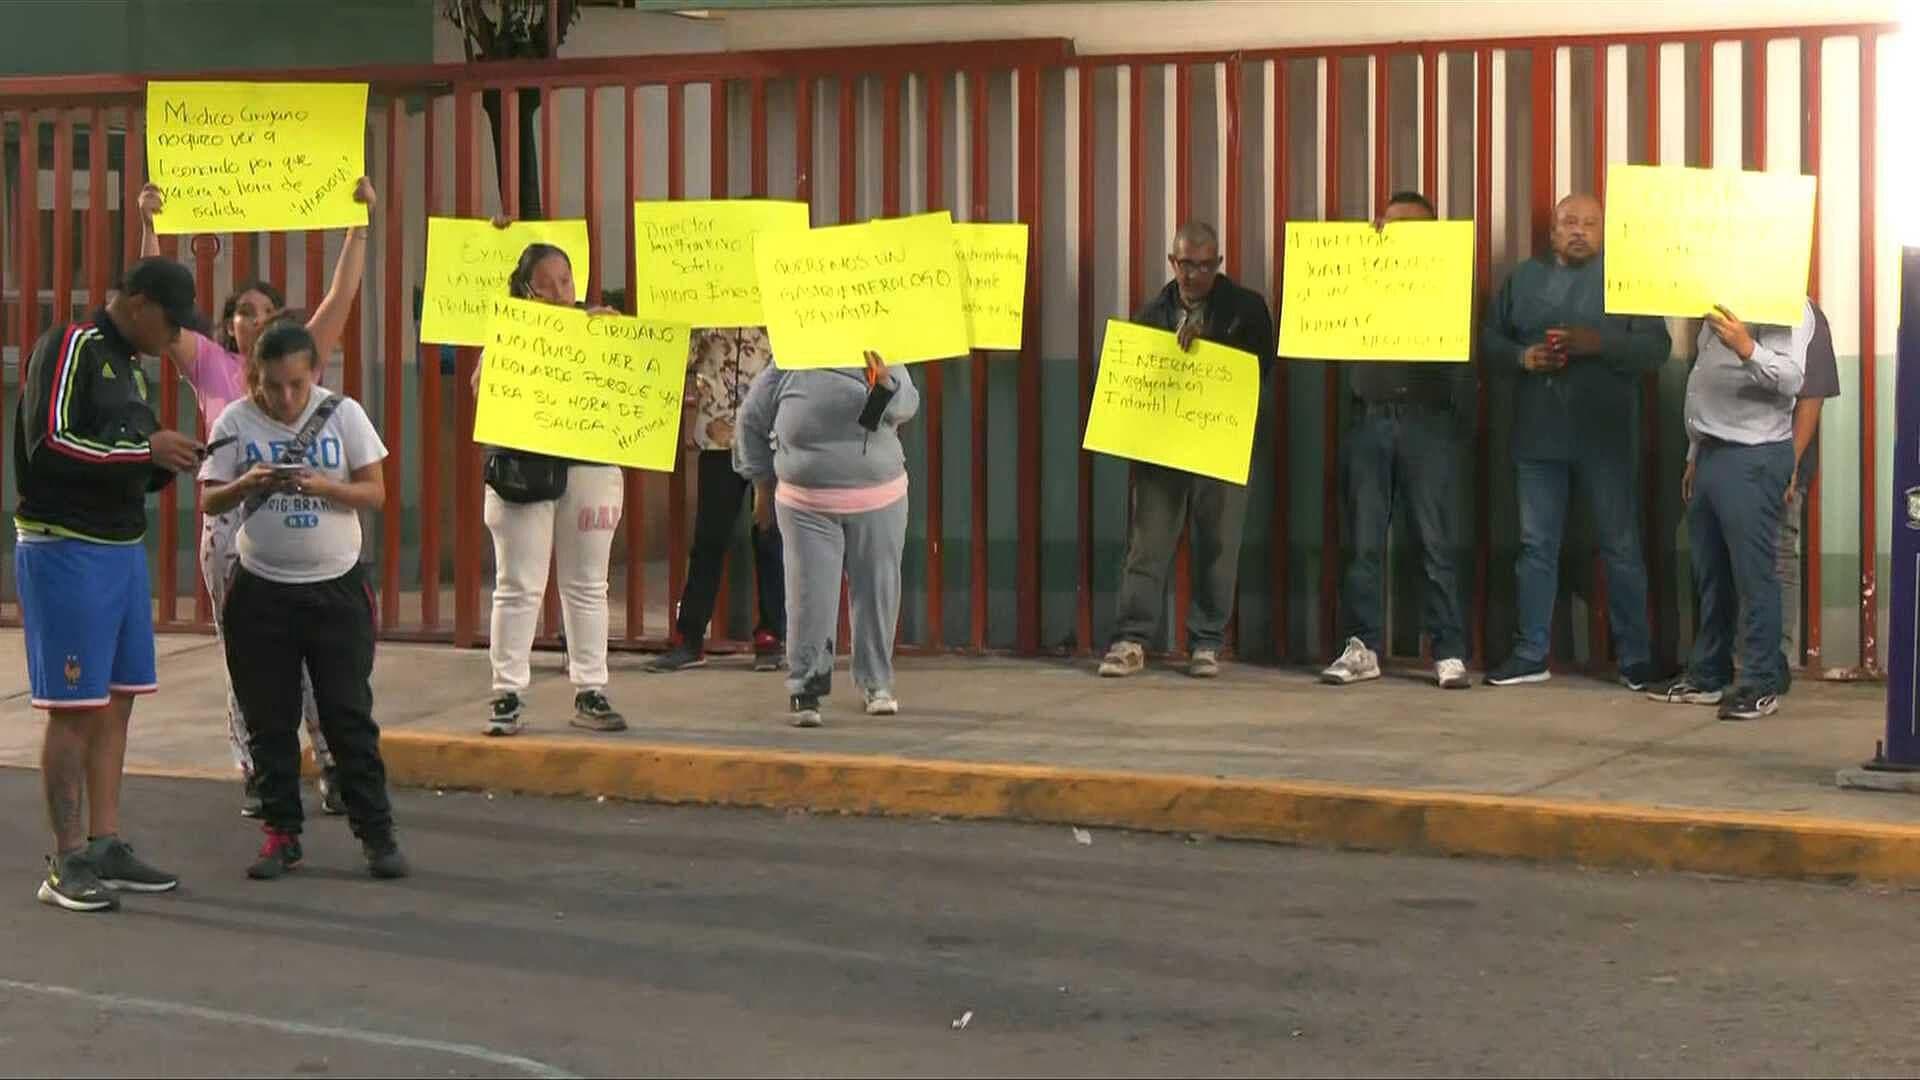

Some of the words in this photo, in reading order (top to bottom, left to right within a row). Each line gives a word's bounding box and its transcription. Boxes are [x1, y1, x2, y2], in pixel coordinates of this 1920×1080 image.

[231, 132, 252, 147] ver
[646, 357, 661, 376] A
[569, 395, 609, 411] HORA
